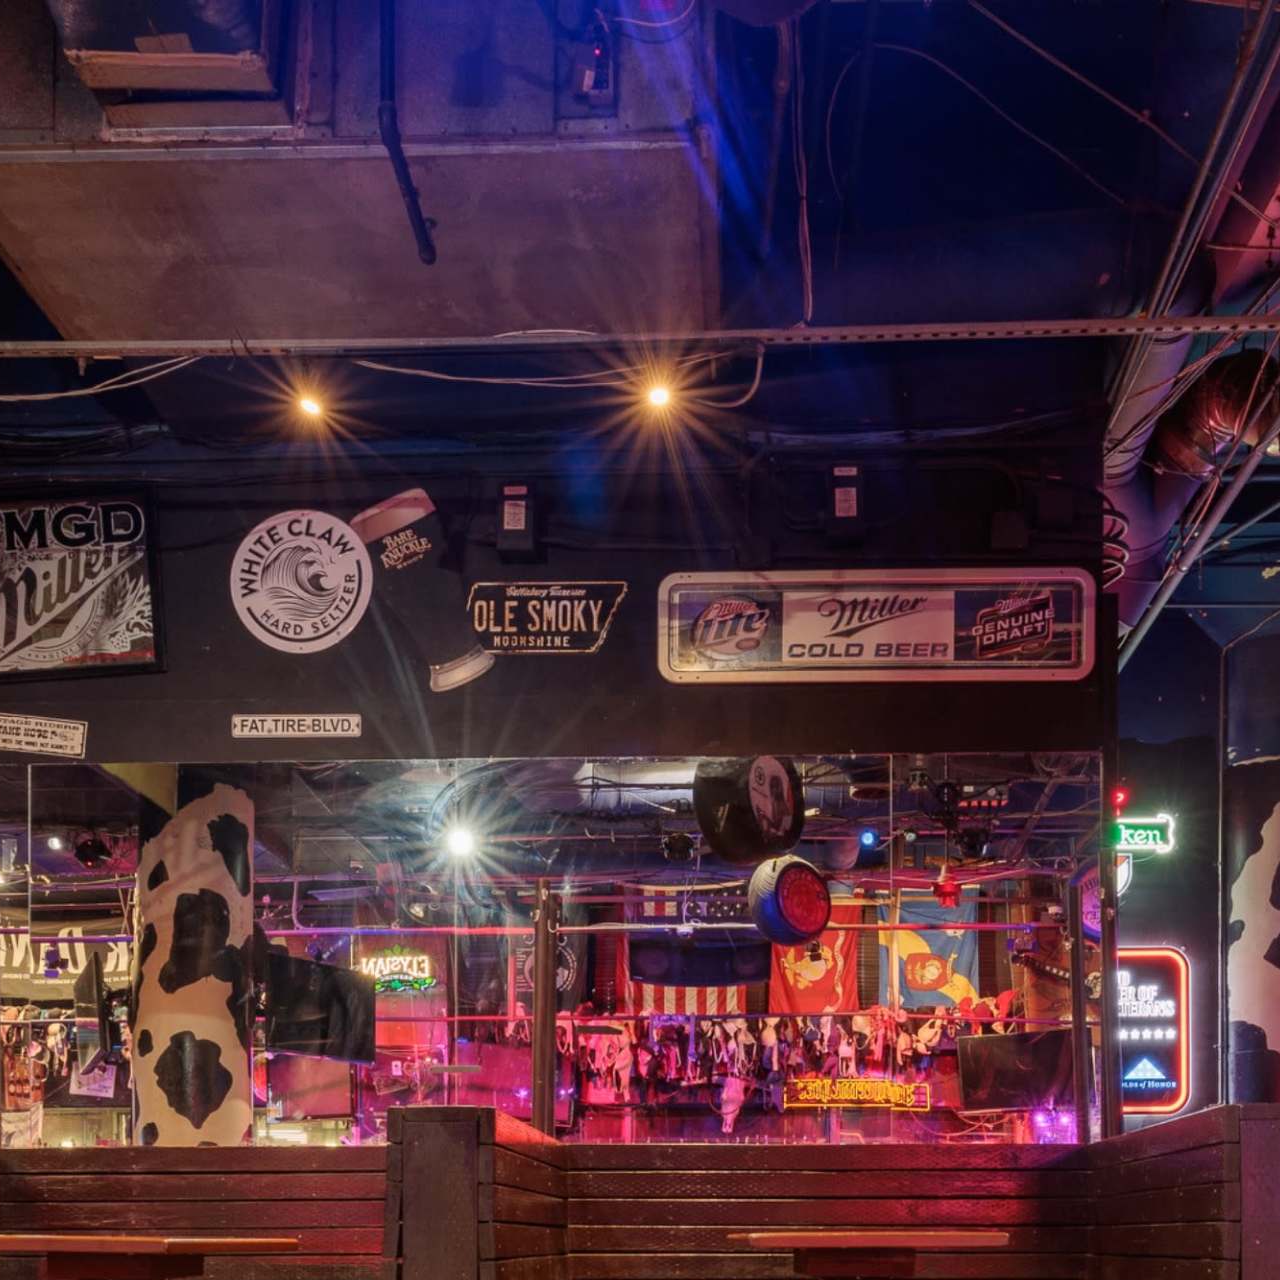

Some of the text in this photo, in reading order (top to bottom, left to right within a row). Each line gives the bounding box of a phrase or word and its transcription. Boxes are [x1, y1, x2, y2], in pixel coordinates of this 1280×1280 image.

[1, 501, 145, 550] MGD
[381, 528, 417, 549] BARE
[239, 518, 356, 599] WHITE CLAW
[379, 537, 432, 568] KNUCKLE
[260, 572, 357, 636] HARD SELTZER
[473, 600, 606, 632] OLE SMOKY
[817, 593, 928, 632] Miller
[971, 607, 1056, 637] GENUINE
[982, 620, 1046, 646] DRAFT
[492, 635, 571, 648] MOONSHINE
[788, 642, 949, 659] COLD BEER
[240, 718, 355, 734] FAT TIRE BLVD.
